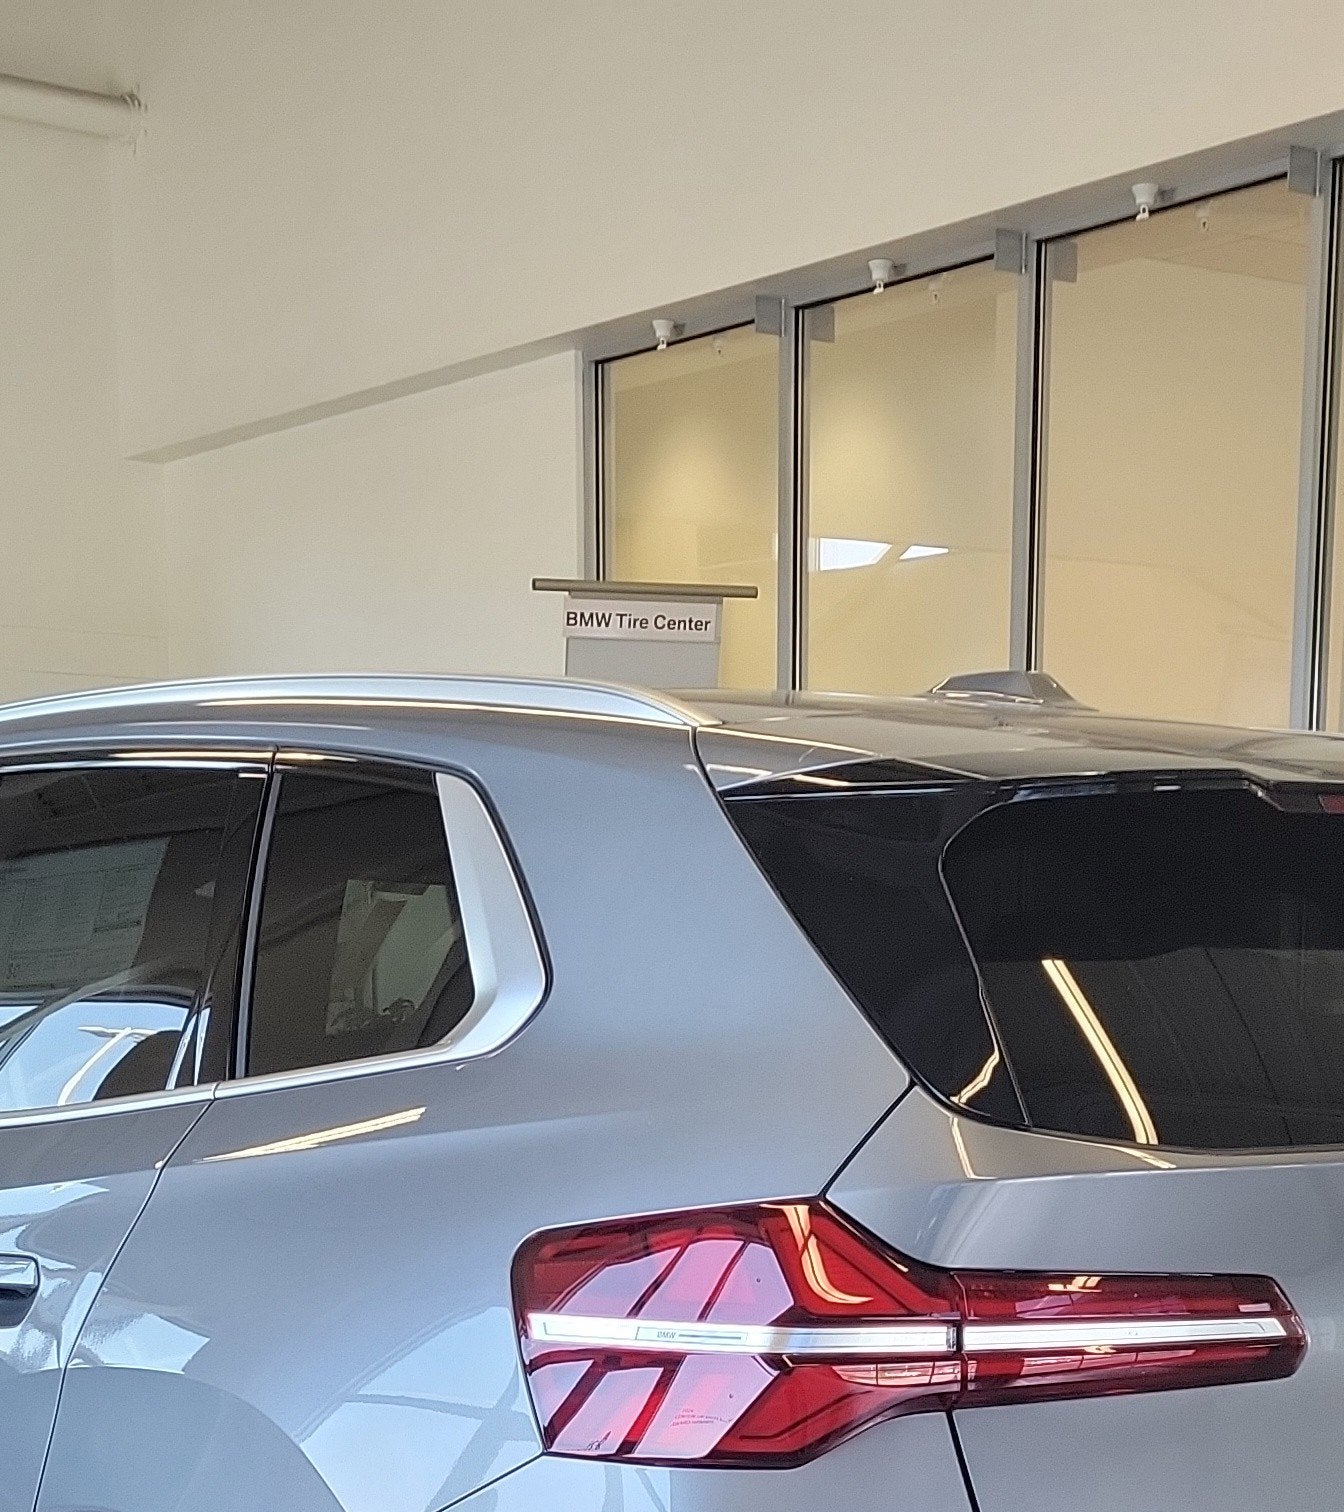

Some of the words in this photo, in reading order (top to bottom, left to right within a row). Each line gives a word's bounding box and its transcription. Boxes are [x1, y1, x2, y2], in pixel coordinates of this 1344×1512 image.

[565, 611, 612, 628] BMW
[616, 613, 649, 630] Tire
[653, 614, 712, 632] Center
